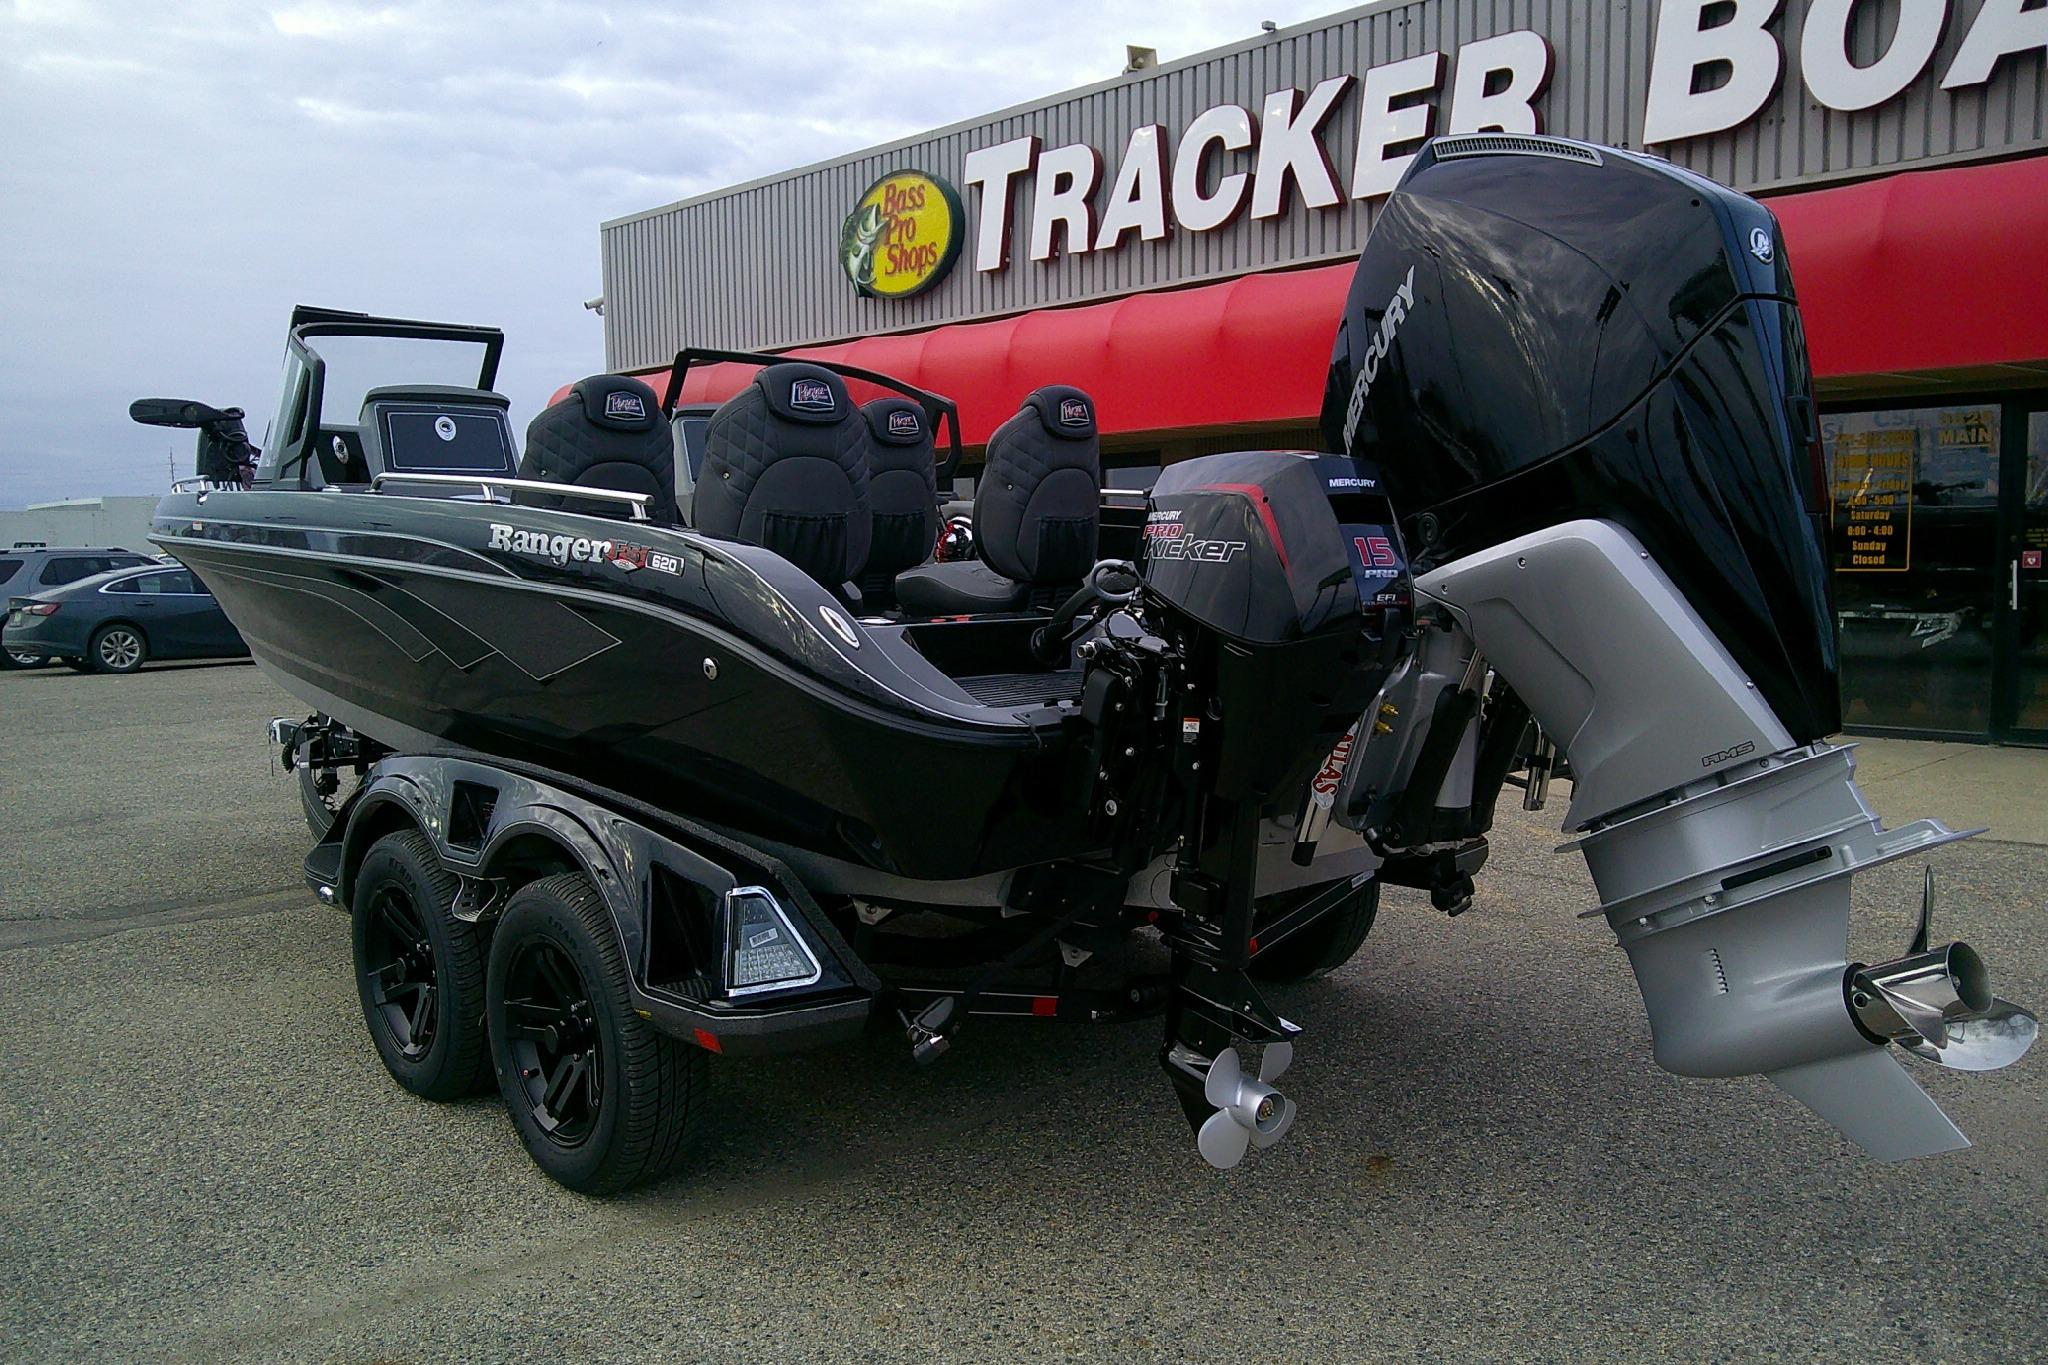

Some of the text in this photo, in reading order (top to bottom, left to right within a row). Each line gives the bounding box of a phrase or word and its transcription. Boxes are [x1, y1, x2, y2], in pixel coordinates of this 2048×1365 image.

[964, 29, 1556, 272] TRACKER
[882, 183, 925, 216] Bass
[884, 214, 917, 246] Pro
[885, 241, 938, 277] Shops
[1342, 264, 1415, 457] MERCURY
[1939, 428, 1993, 446] MAIN
[1328, 478, 1376, 488] MERCURY
[1147, 510, 1182, 521] MERCURY
[1851, 510, 1890, 520] Saturday
[1142, 523, 1184, 540] PRO
[1873, 525, 1893, 536] 4:00
[488, 523, 612, 568] Ranger
[651, 554, 678, 572] 620
[1353, 537, 1396, 566] 15
[1852, 540, 1887, 551] Sunday
[1852, 554, 1885, 565] Closed
[1364, 569, 1399, 578] PRO
[1376, 593, 1396, 602] EFI
